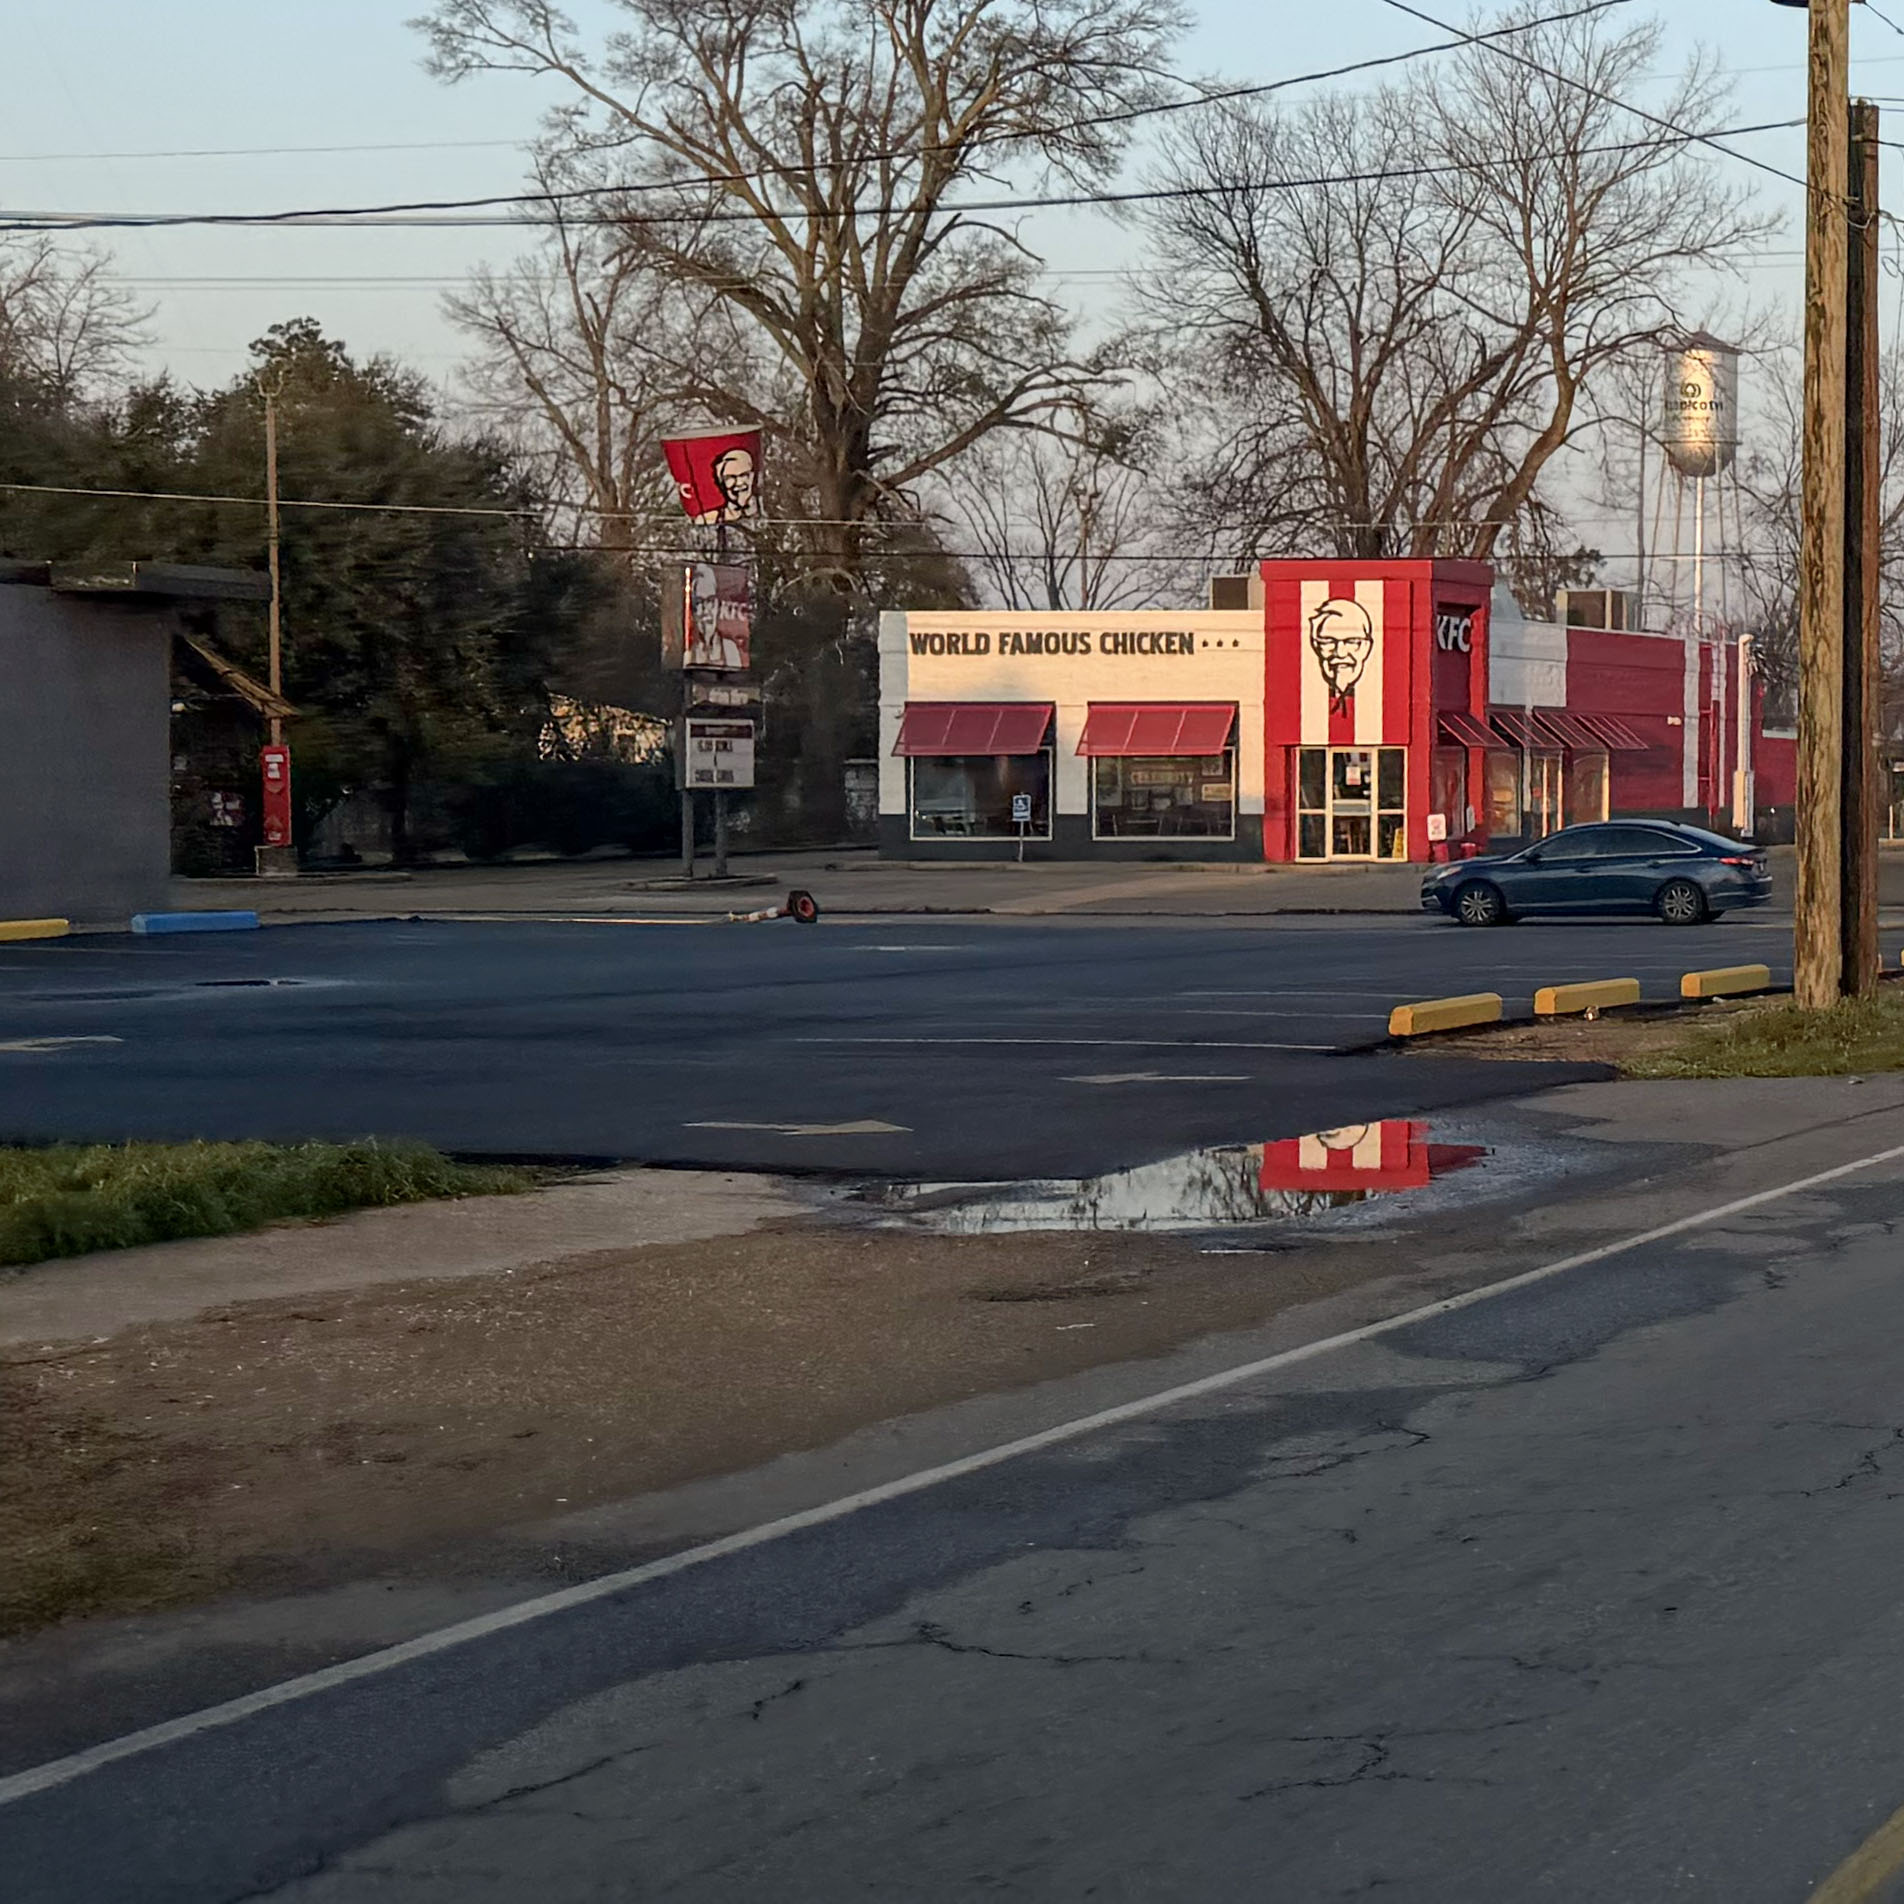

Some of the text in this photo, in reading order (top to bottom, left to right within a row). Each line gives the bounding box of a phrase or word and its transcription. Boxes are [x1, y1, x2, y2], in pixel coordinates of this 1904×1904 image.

[909, 632, 991, 655] WORLD
[998, 632, 1092, 655] FAMOUS
[1100, 631, 1195, 655] CHICKEN
[1437, 614, 1471, 653] KFC
